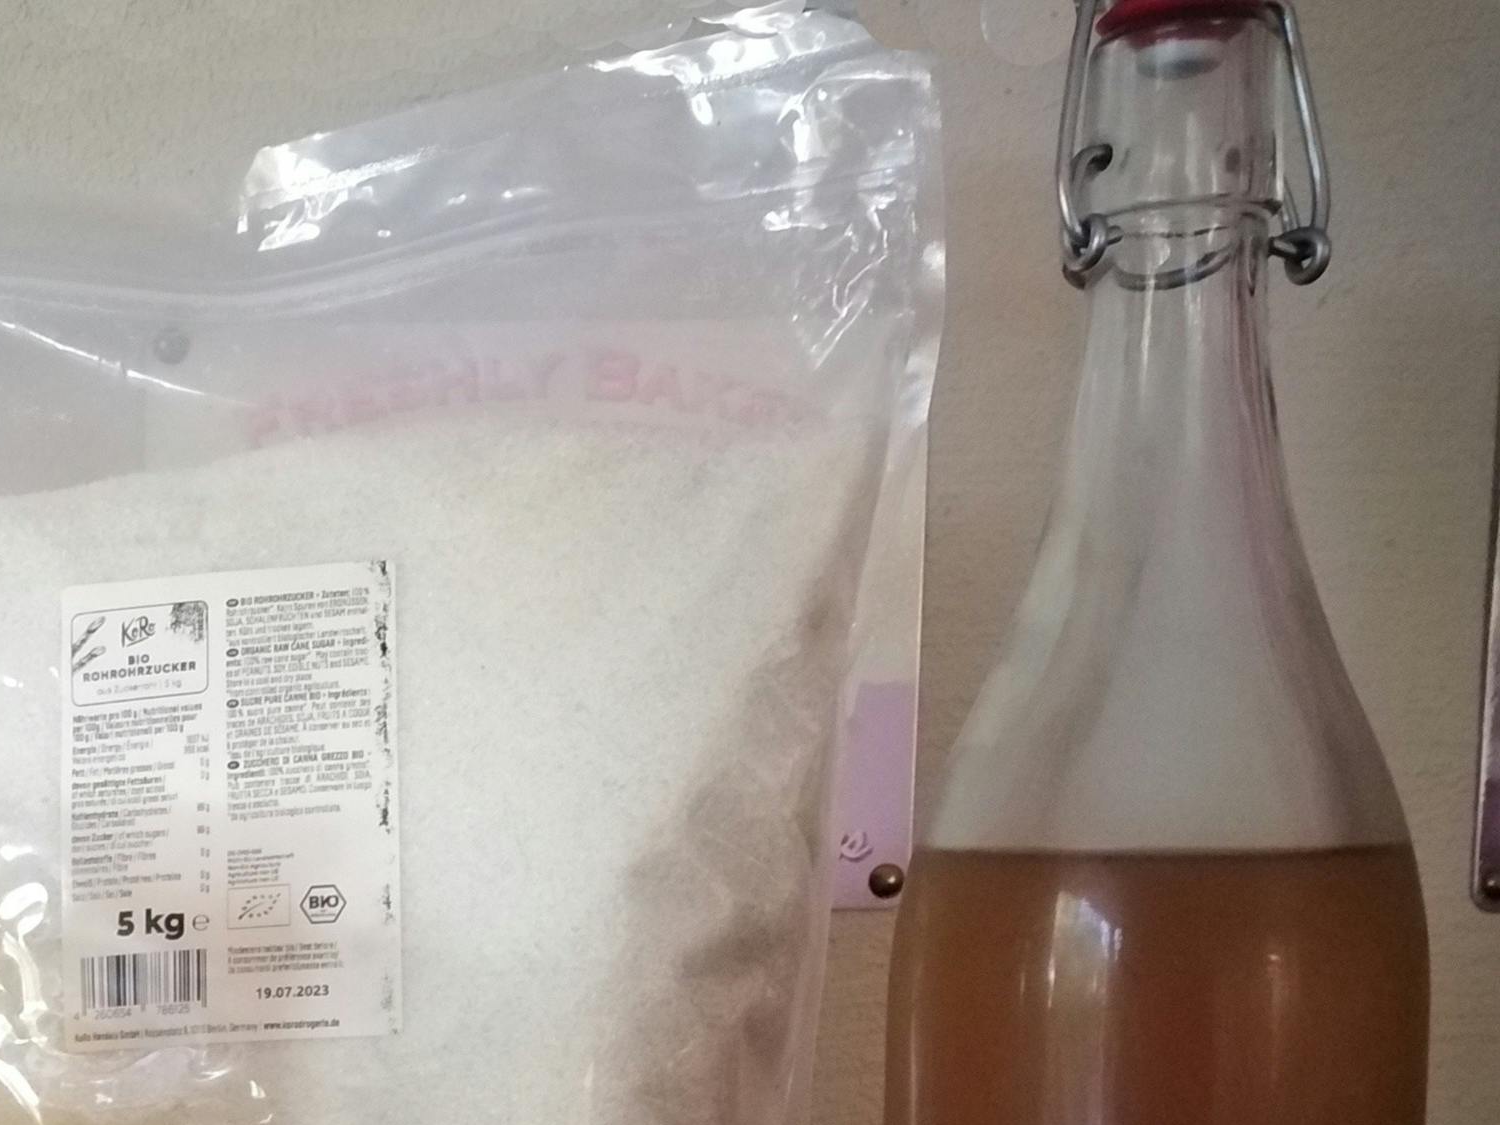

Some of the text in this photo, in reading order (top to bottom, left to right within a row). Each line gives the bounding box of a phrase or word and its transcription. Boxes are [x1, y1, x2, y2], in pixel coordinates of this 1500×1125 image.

[128, 655, 150, 665] BIO
[83, 661, 196, 682] ROHROHRZUCKER
[309, 895, 338, 909] BIO
[117, 910, 134, 936] 5
[145, 908, 184, 940] kg
[256, 985, 329, 999] 19.07.2023
